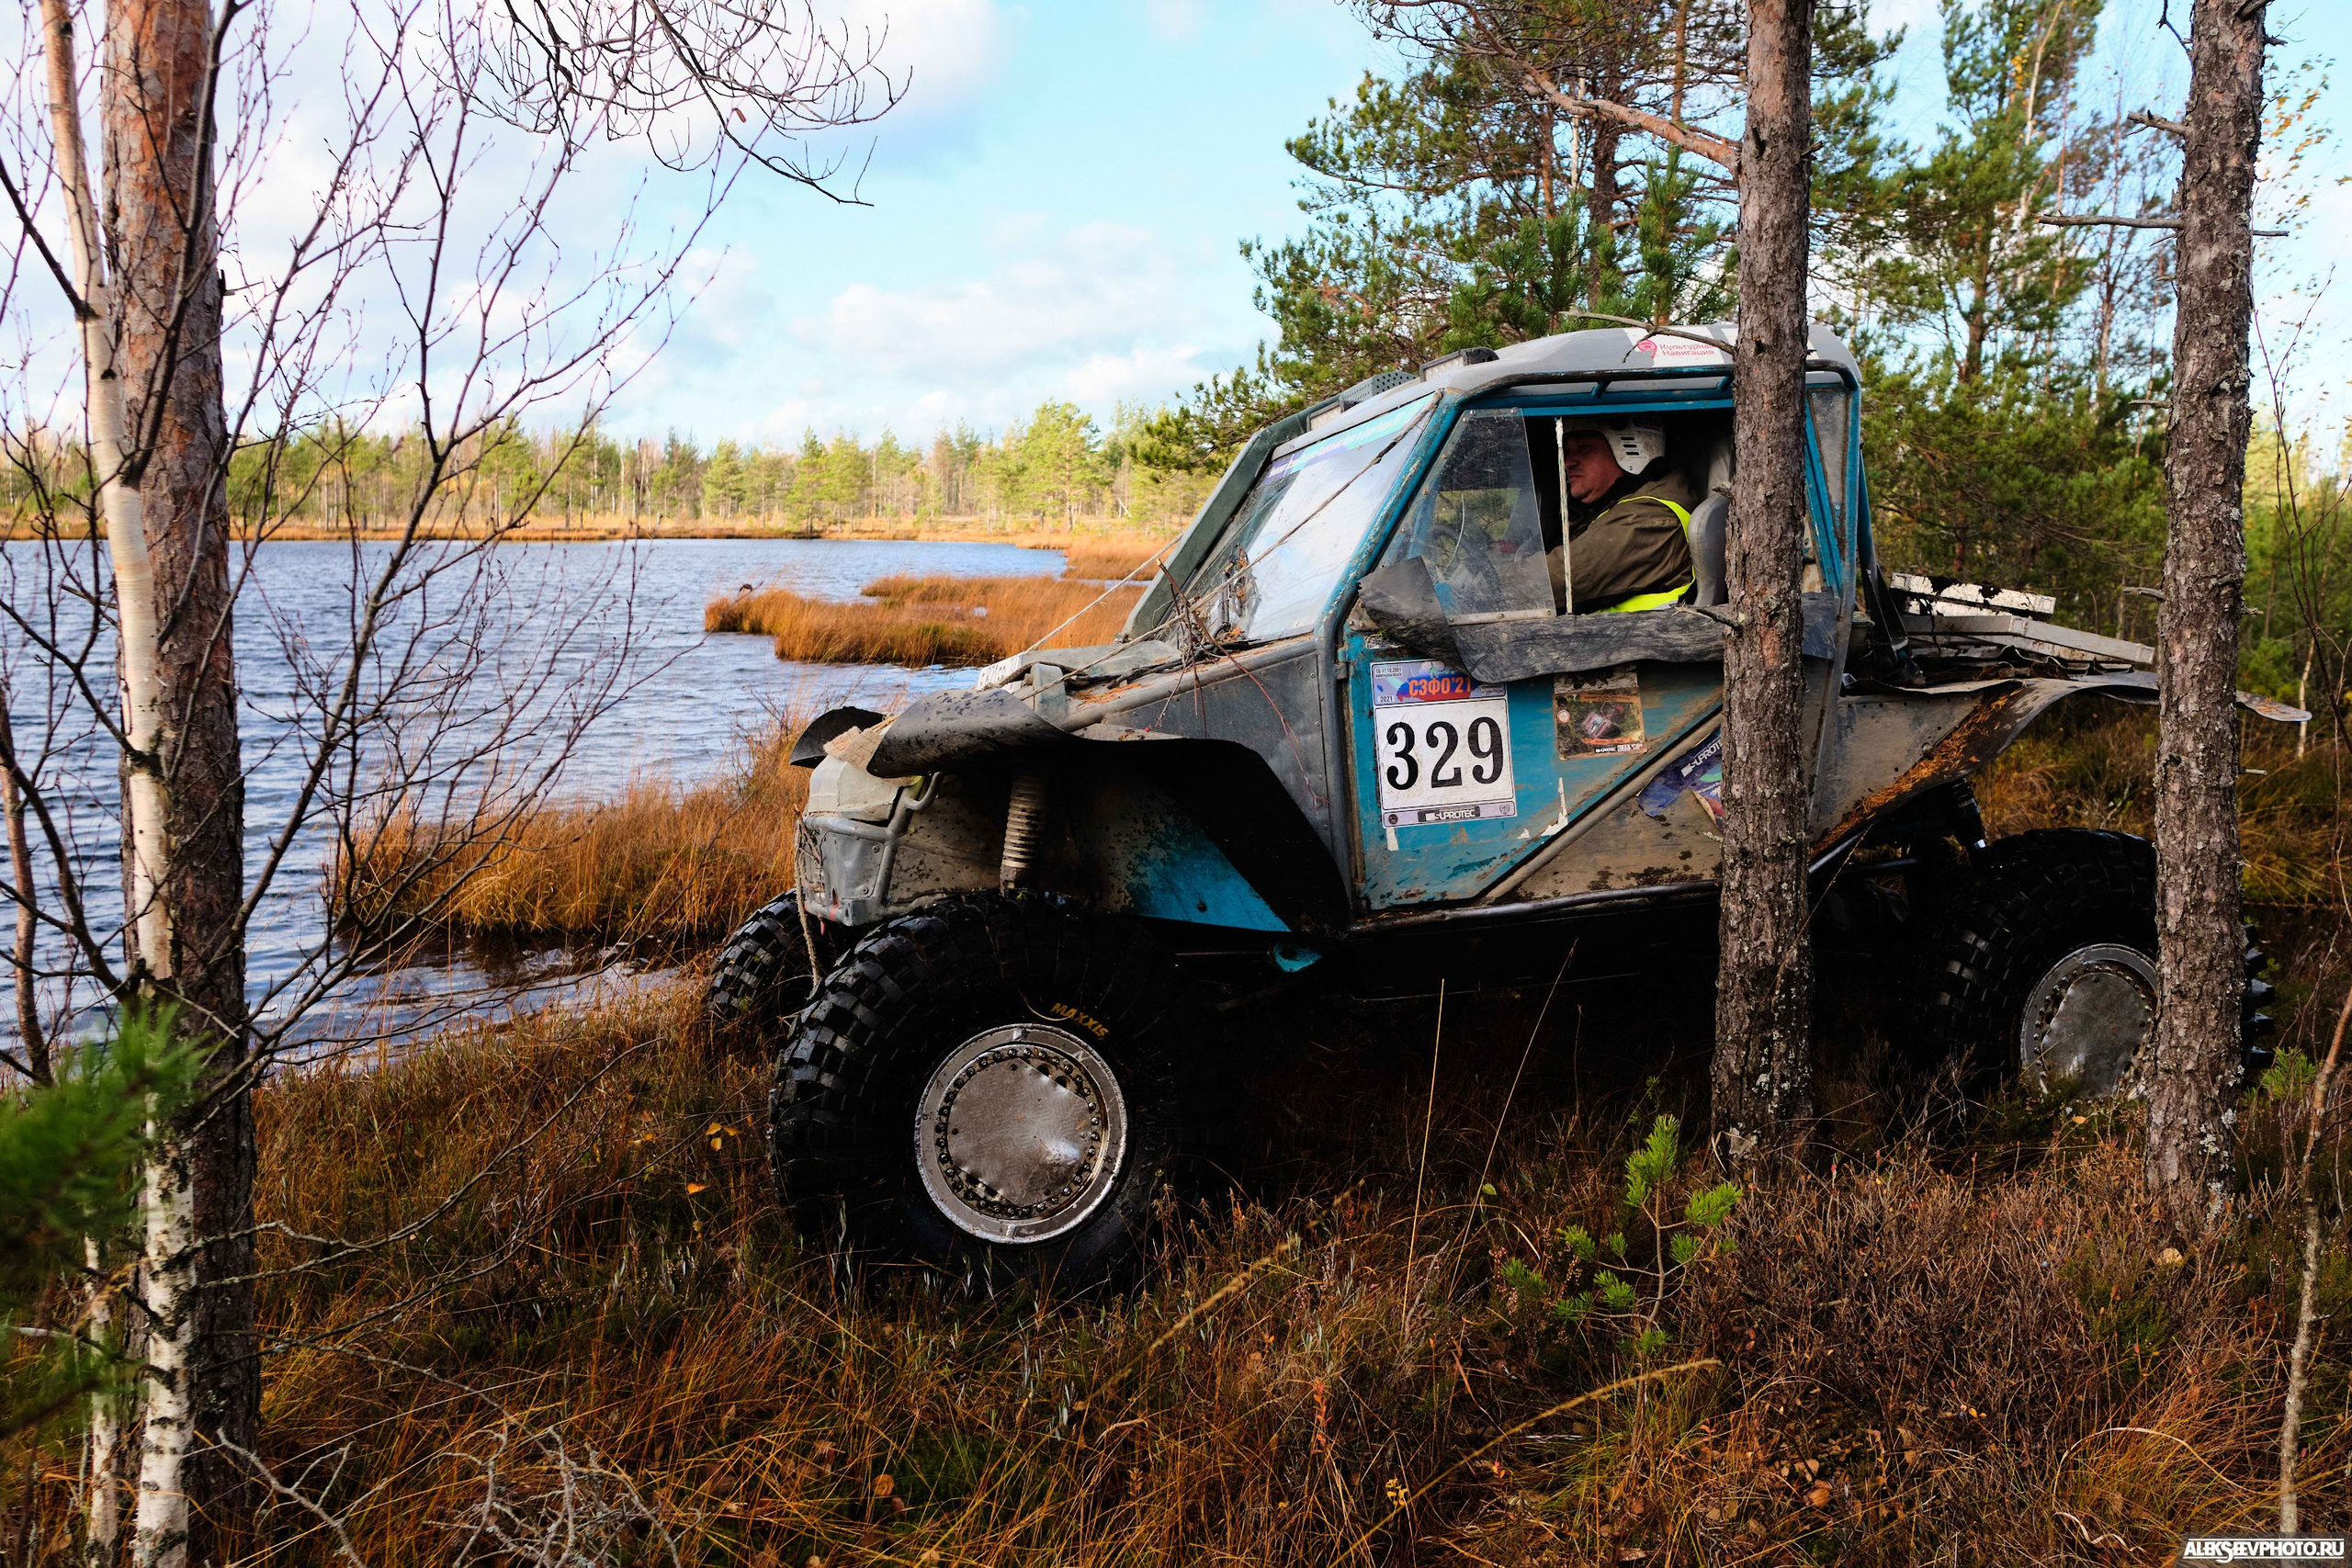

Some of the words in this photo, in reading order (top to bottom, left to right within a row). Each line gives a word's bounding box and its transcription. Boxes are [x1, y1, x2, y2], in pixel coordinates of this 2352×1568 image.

[1386, 716, 1504, 790] 329
[1433, 808, 1476, 820] SUPROTEC
[1050, 1002, 1110, 1038] MAXXIS
